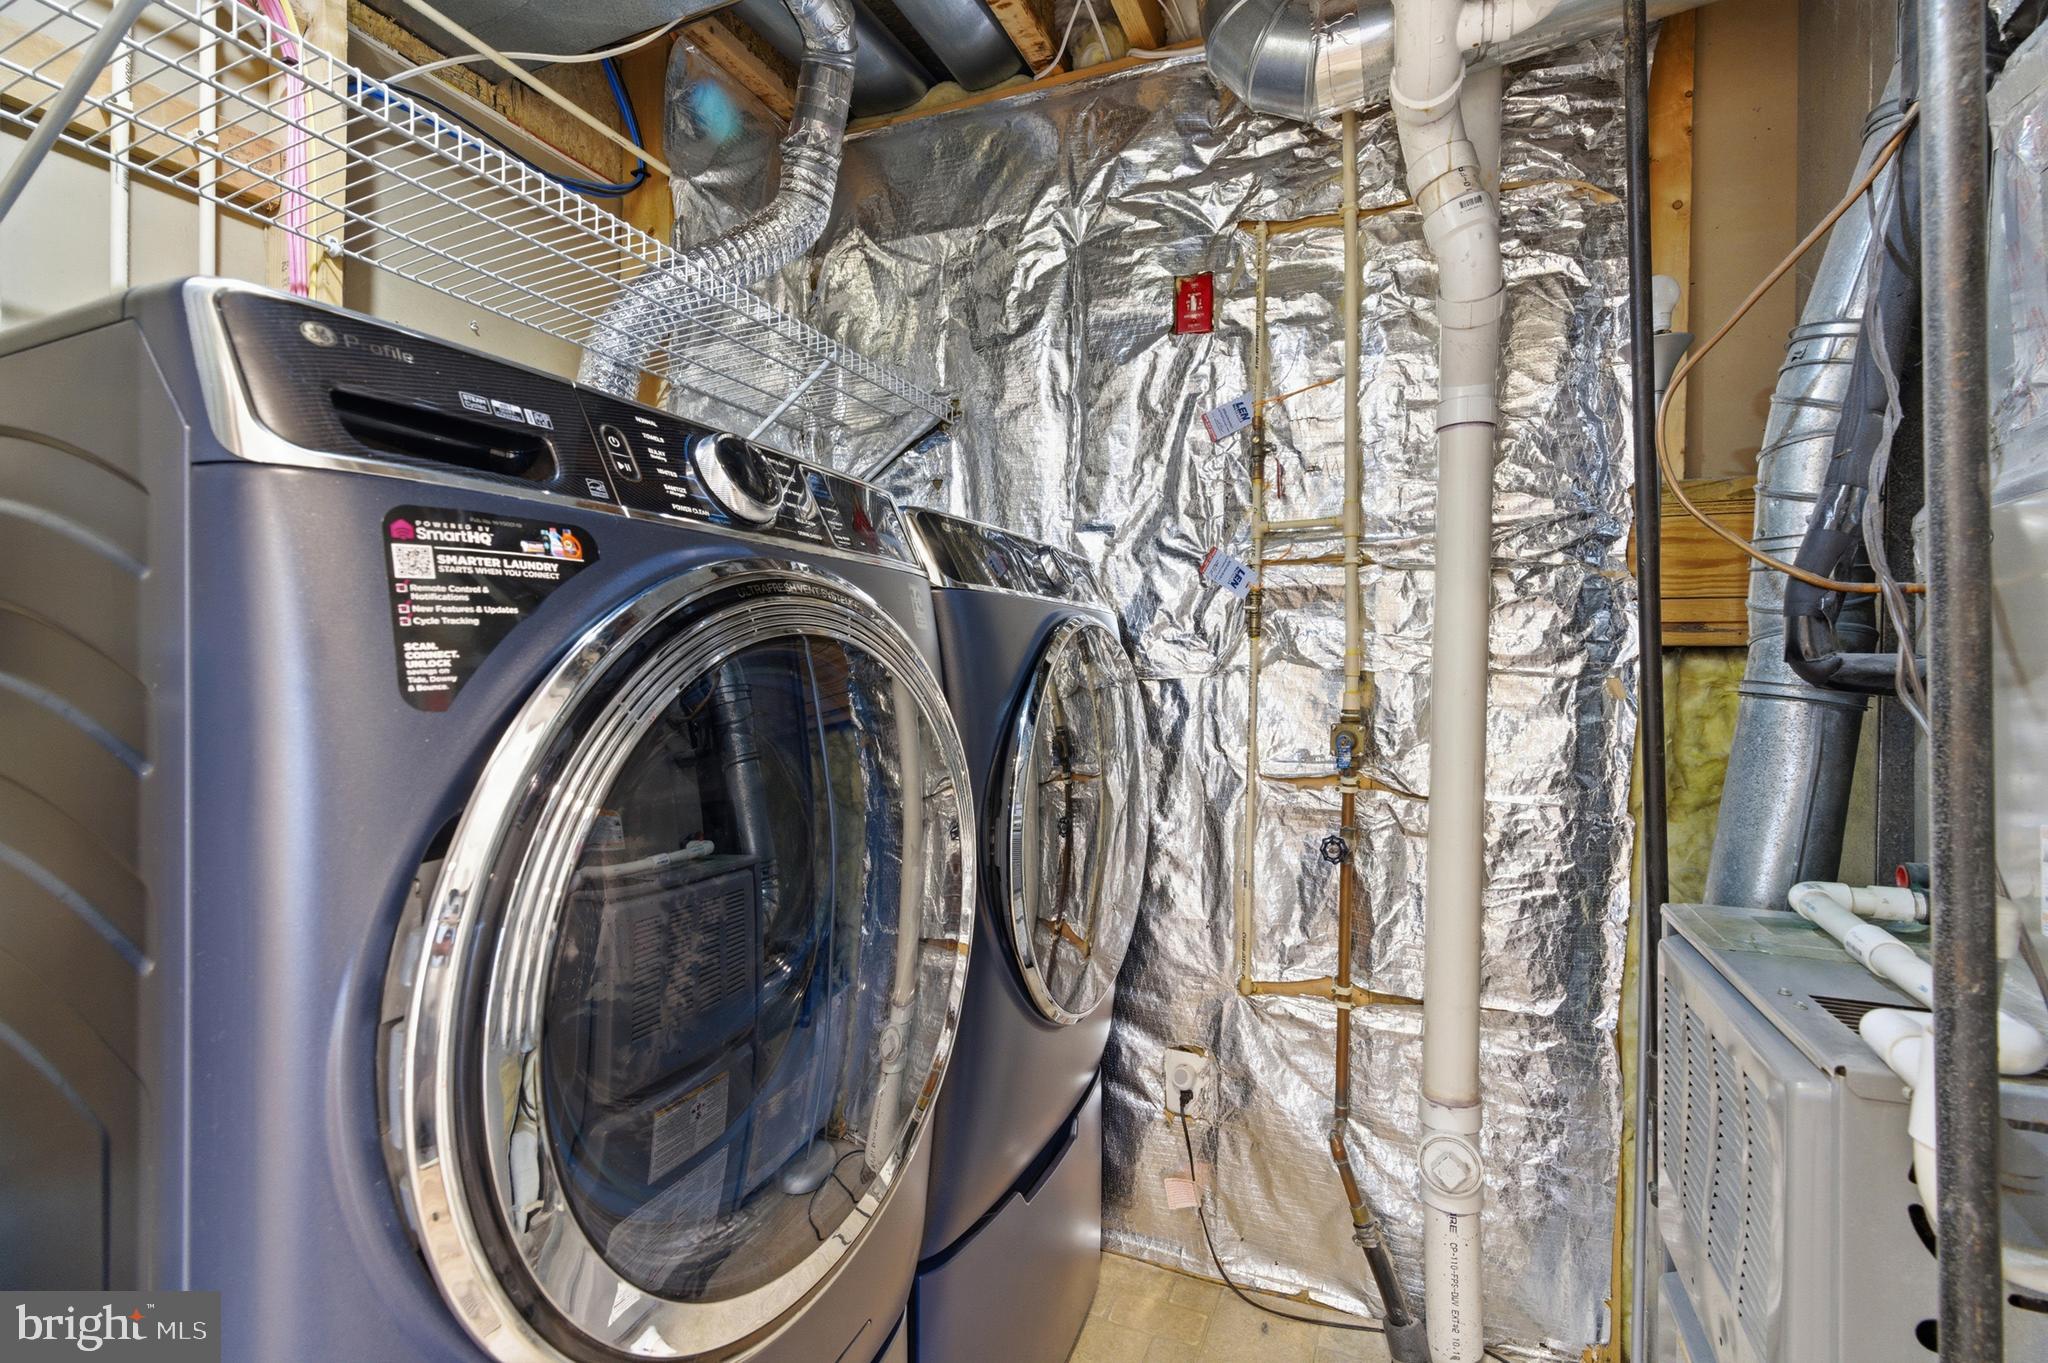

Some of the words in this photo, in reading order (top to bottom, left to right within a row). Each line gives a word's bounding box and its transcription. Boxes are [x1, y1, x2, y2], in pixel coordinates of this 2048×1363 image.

[343, 333, 415, 364] Pofile
[1235, 402, 1251, 421] LEN
[415, 520, 472, 531] POWERED
[477, 525, 490, 533] BY
[436, 554, 501, 568] SMARTER
[502, 558, 559, 572] LAUNDRY
[438, 565, 474, 574] STARTS
[474, 567, 503, 576] WHEN
[503, 568, 522, 577] YOU
[522, 570, 560, 580] CONNECT
[1230, 568, 1246, 589] LEN
[410, 583, 447, 593] Remote
[448, 584, 481, 594] Control
[482, 586, 490, 594] &
[410, 592, 470, 602] Notifications
[411, 604, 434, 613] New
[435, 604, 475, 613] Features
[475, 605, 483, 613] &
[483, 606, 519, 614] Updates
[413, 617, 440, 626] Cycle
[441, 617, 480, 626] Tracking
[403, 642, 439, 651] SCAN.
[405, 659, 452, 669] UNLOCK
